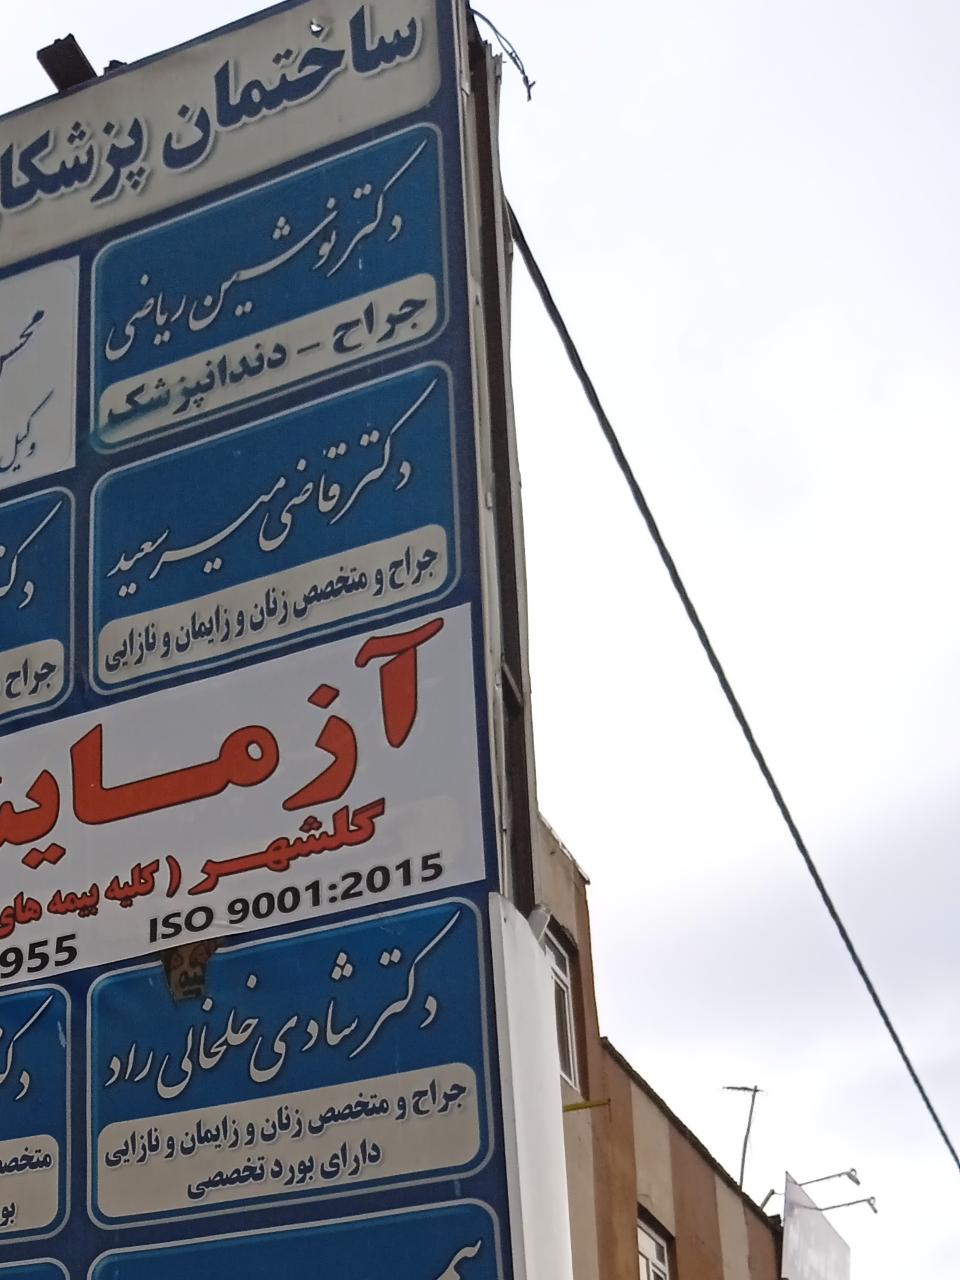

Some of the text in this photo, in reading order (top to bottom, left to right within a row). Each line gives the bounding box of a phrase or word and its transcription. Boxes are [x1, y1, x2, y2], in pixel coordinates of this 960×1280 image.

[163, 5, 423, 171] ساختمان
[105, 140, 427, 361] دکتر نوشین ریاضی
[333, 298, 428, 354] جراح
[107, 342, 288, 424] دندانپزشک
[258, 442, 347, 552] قاضی
[330, 377, 437, 525] دکتر
[105, 546, 438, 673] جراح و متخصص زنان و زایمان و نازایی
[5, 658, 57, 698] جراح
[188, 797, 386, 895] گلشهر
[46, 883, 100, 918] بیمه
[149, 852, 444, 944] ISO 9001:2015
[249, 951, 359, 1083] شادی
[349, 909, 462, 1059] دکتر
[105, 1042, 154, 1088] راد
[156, 974, 260, 1099] خلخالی
[104, 1079, 468, 1168] جراح و متخصص زنان و زایمان و نازایی
[186, 1138, 382, 1201] دارای بورد تخصصی
